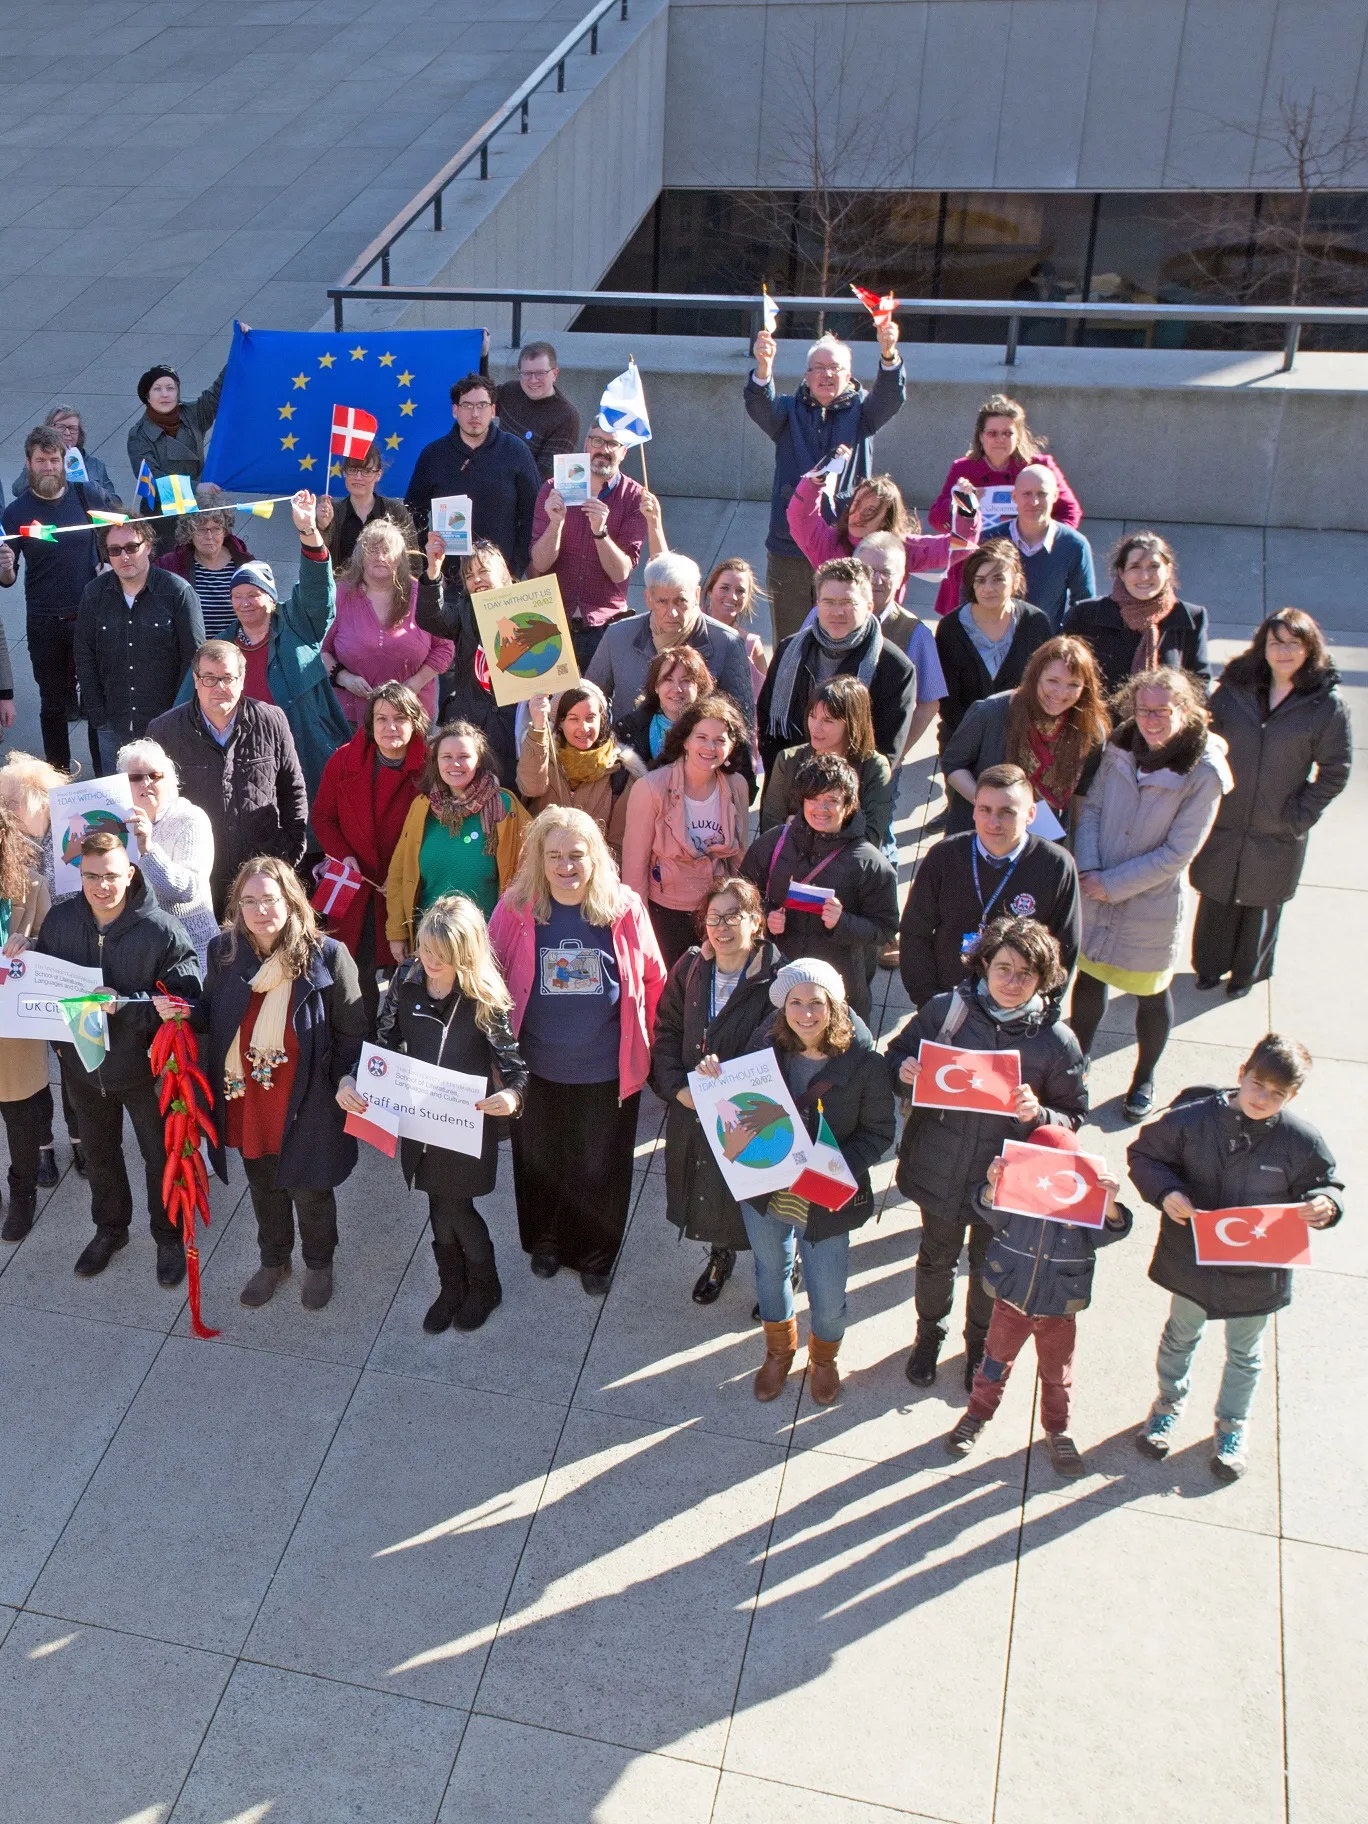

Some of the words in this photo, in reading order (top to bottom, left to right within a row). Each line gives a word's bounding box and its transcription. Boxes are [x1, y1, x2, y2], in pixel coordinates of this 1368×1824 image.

[502, 591, 538, 606] WITHOUT
[540, 589, 552, 598] US
[77, 790, 111, 802] WITHOUT
[34, 978, 64, 988] Languages
[26, 1002, 41, 1011] UK
[45, 1002, 60, 1013] Cit
[396, 1073, 417, 1084] School
[718, 1068, 755, 1085] WITHOUT
[757, 1064, 769, 1074] US
[750, 1074, 772, 1086] 20/02
[443, 1094, 470, 1105] Cultures
[362, 1092, 390, 1108] Staff
[393, 1101, 416, 1115] and
[420, 1108, 475, 1129] Students
